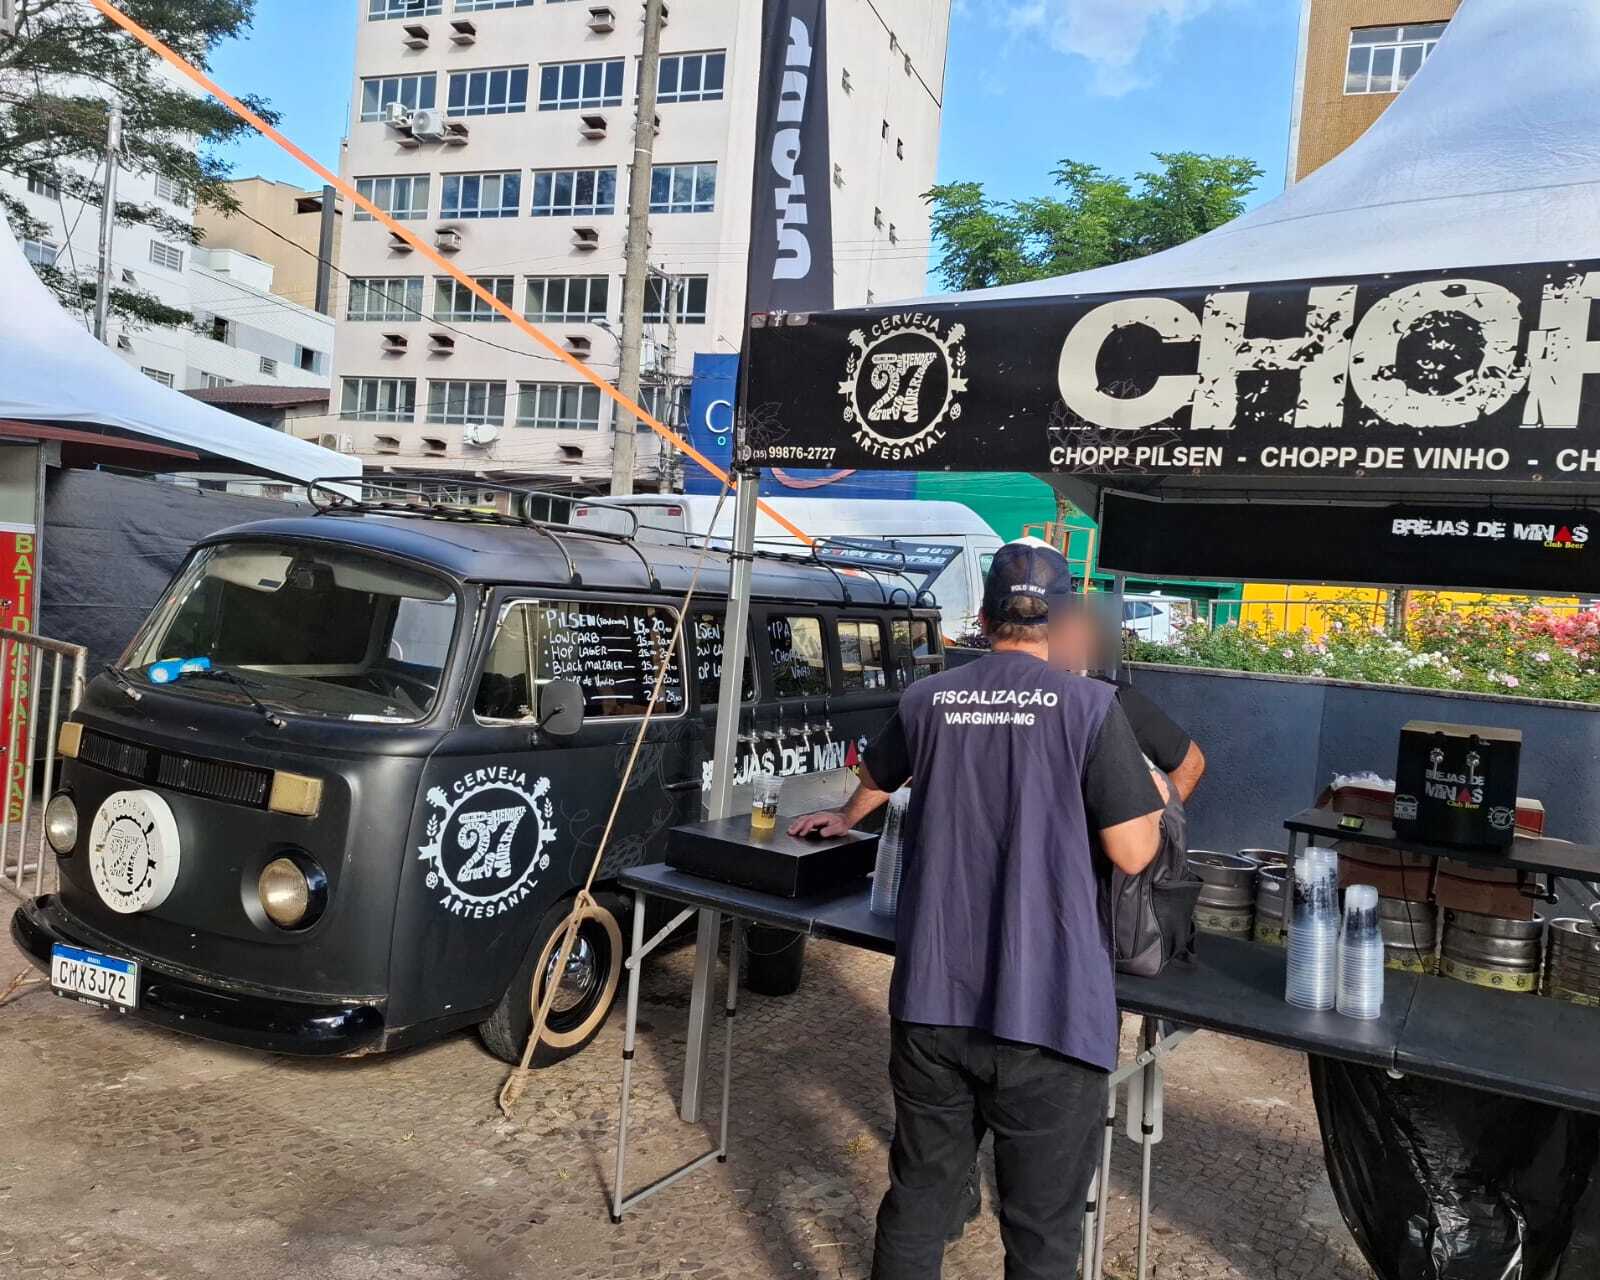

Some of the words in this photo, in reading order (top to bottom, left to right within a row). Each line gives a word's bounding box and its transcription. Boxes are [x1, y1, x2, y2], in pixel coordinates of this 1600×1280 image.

[872, 312, 940, 336] CERVEJA
[868, 352, 937, 423] 27
[768, 446, 837, 461] 99876-2727
[851, 430, 946, 461] ARTESANAL
[1050, 447, 1129, 467] CHOPP
[1136, 447, 1223, 467] PILSEN
[1261, 447, 1357, 468] CHOPP
[1365, 447, 1404, 469] DE
[1413, 448, 1510, 471] VINHO
[1392, 519, 1470, 536] BREJAS
[1473, 522, 1507, 539] DE
[546, 609, 596, 629] PILSEN
[551, 645, 574, 660] HOP
[578, 645, 608, 659] LAGER
[932, 689, 1058, 708] FISCALIZAÇÃO
[779, 744, 808, 777] DE
[453, 766, 527, 793] CERVEJA
[456, 805, 527, 883] 27
[438, 879, 539, 919] ARTESANAL
